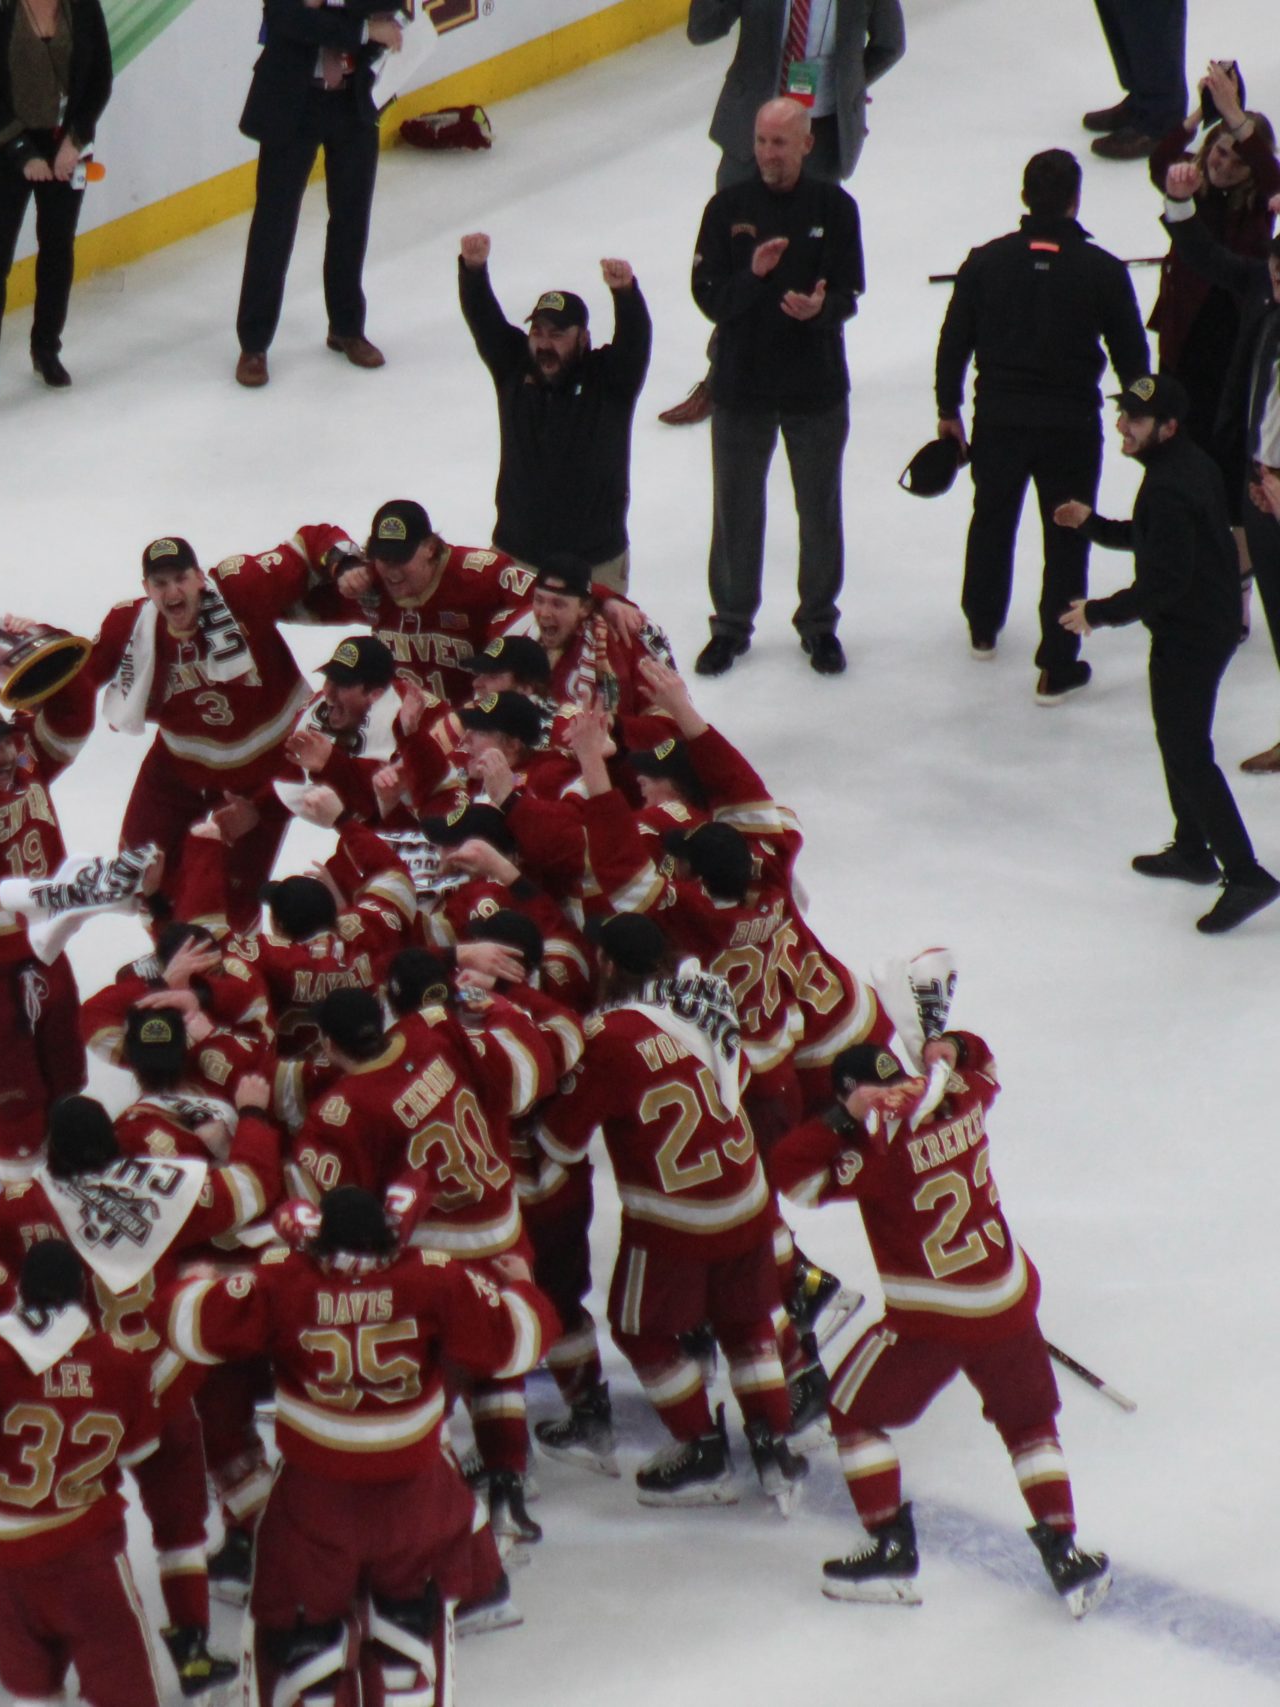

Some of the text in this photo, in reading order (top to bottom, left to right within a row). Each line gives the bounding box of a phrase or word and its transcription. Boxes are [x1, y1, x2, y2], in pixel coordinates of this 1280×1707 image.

[195, 691, 235, 726] 3
[6, 829, 49, 882] 19
[408, 1087, 512, 1213] 30
[316, 1289, 394, 1325] DAVIS
[43, 1363, 94, 1399] LEE
[298, 1319, 422, 1411] 35
